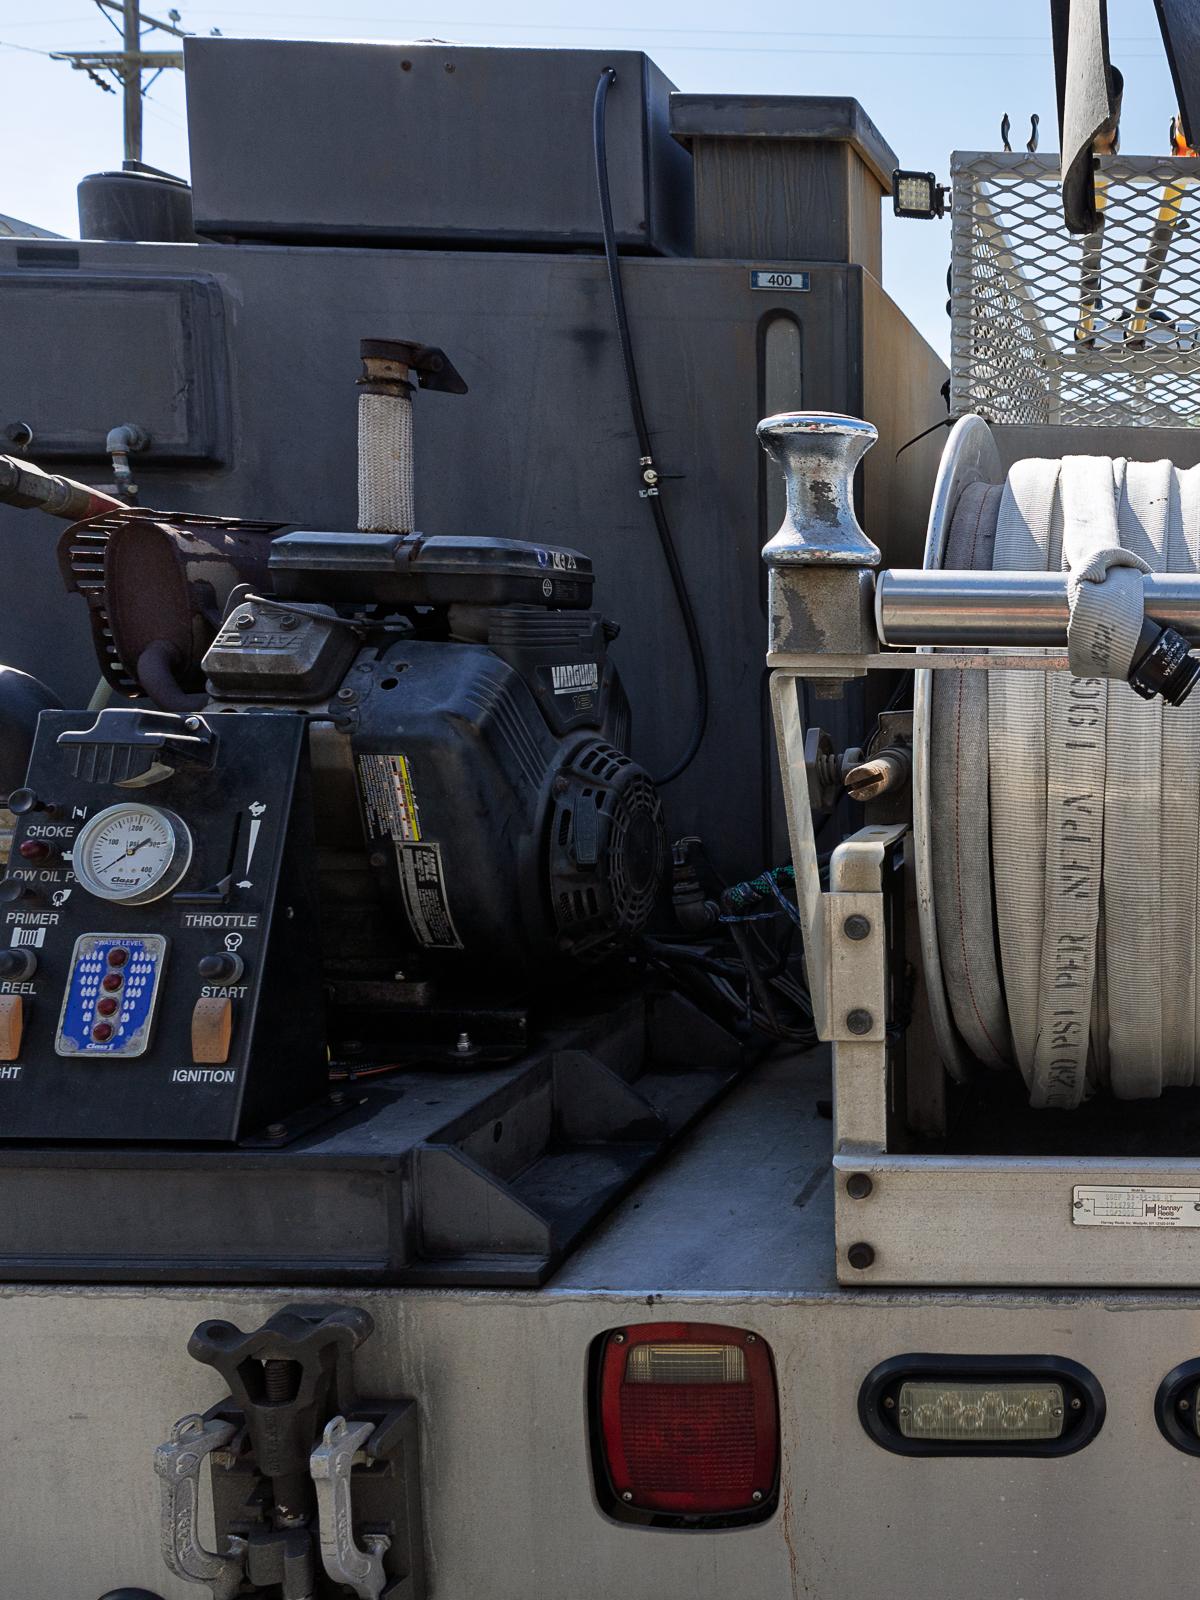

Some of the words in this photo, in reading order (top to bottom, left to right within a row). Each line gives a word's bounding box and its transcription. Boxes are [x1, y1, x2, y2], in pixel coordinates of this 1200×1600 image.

[768, 274, 793, 287] 400
[551, 663, 598, 689] VANGUARD
[26, 826, 75, 838] CHOKE
[131, 824, 144, 832] 200
[129, 840, 140, 848] psi
[1059, 794, 1093, 898] NFPA
[40, 870, 61, 882] OIL
[5, 912, 60, 925] PRIMER
[185, 914, 258, 927] THROTTLE
[1055, 935, 1088, 989] PER
[1, 982, 37, 995] REEL
[200, 986, 248, 999] START
[1051, 1010, 1082, 1049] PSI
[172, 1069, 236, 1083] IGNITION
[1157, 1204, 1181, 1213] Hannay
